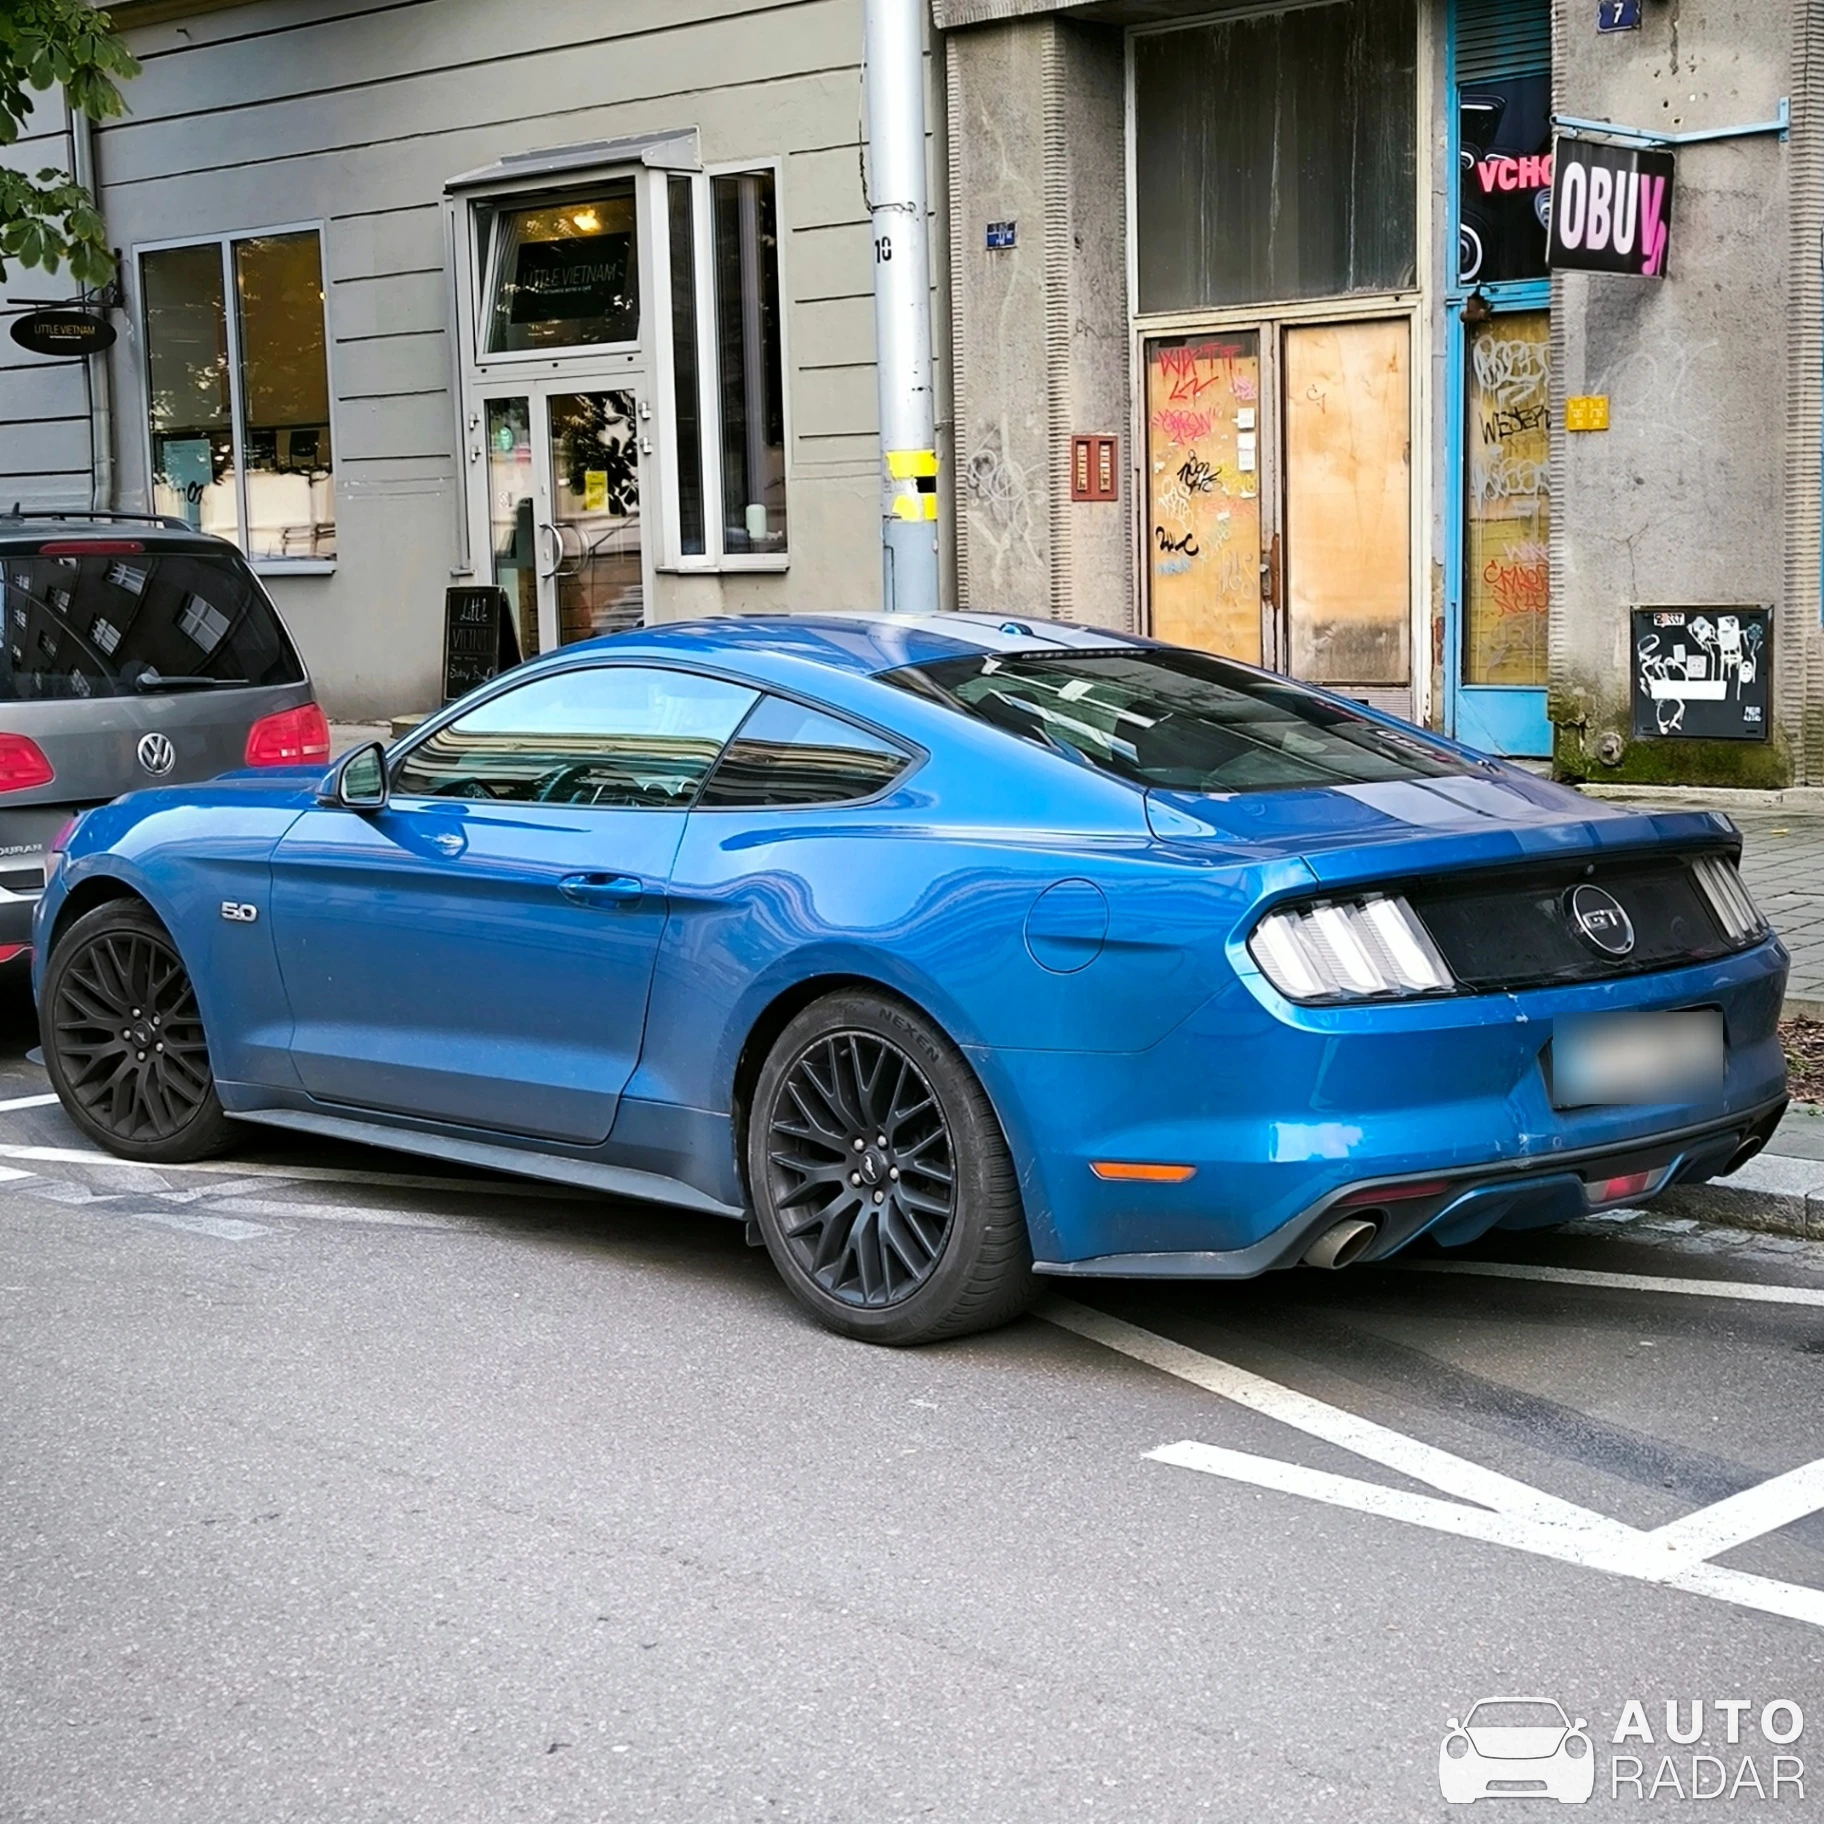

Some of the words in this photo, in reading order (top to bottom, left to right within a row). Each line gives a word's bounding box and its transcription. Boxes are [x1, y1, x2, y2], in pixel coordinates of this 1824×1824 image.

[1614, 3, 1624, 24] 7
[1559, 161, 1667, 276] OBUV
[874, 236, 892, 264] 10
[523, 267, 561, 289] LITTLE
[562, 263, 617, 286] VIETNAM
[34, 324, 59, 335] LITTLE
[60, 325, 96, 335] VIETNAM
[1582, 909, 1620, 930] GT
[880, 1008, 939, 1062] NEXEN
